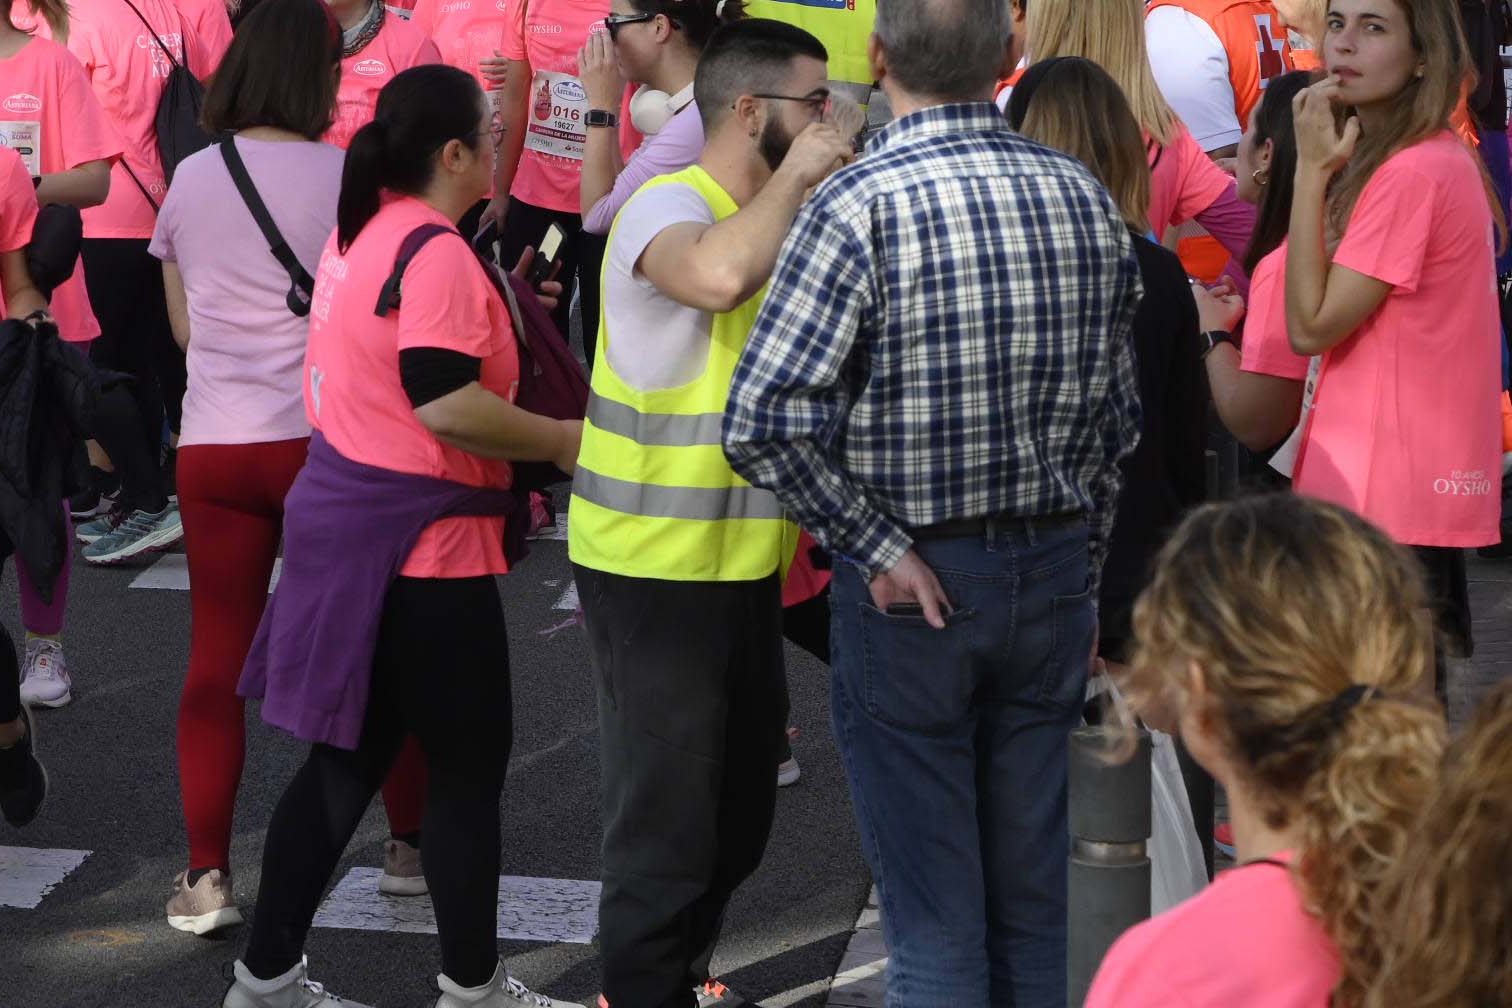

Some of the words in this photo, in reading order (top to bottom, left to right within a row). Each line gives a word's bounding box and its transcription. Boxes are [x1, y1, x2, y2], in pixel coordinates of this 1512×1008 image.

[553, 105, 581, 121] 016
[553, 120, 576, 132] 19627
[1433, 478, 1492, 496] OYSHO
